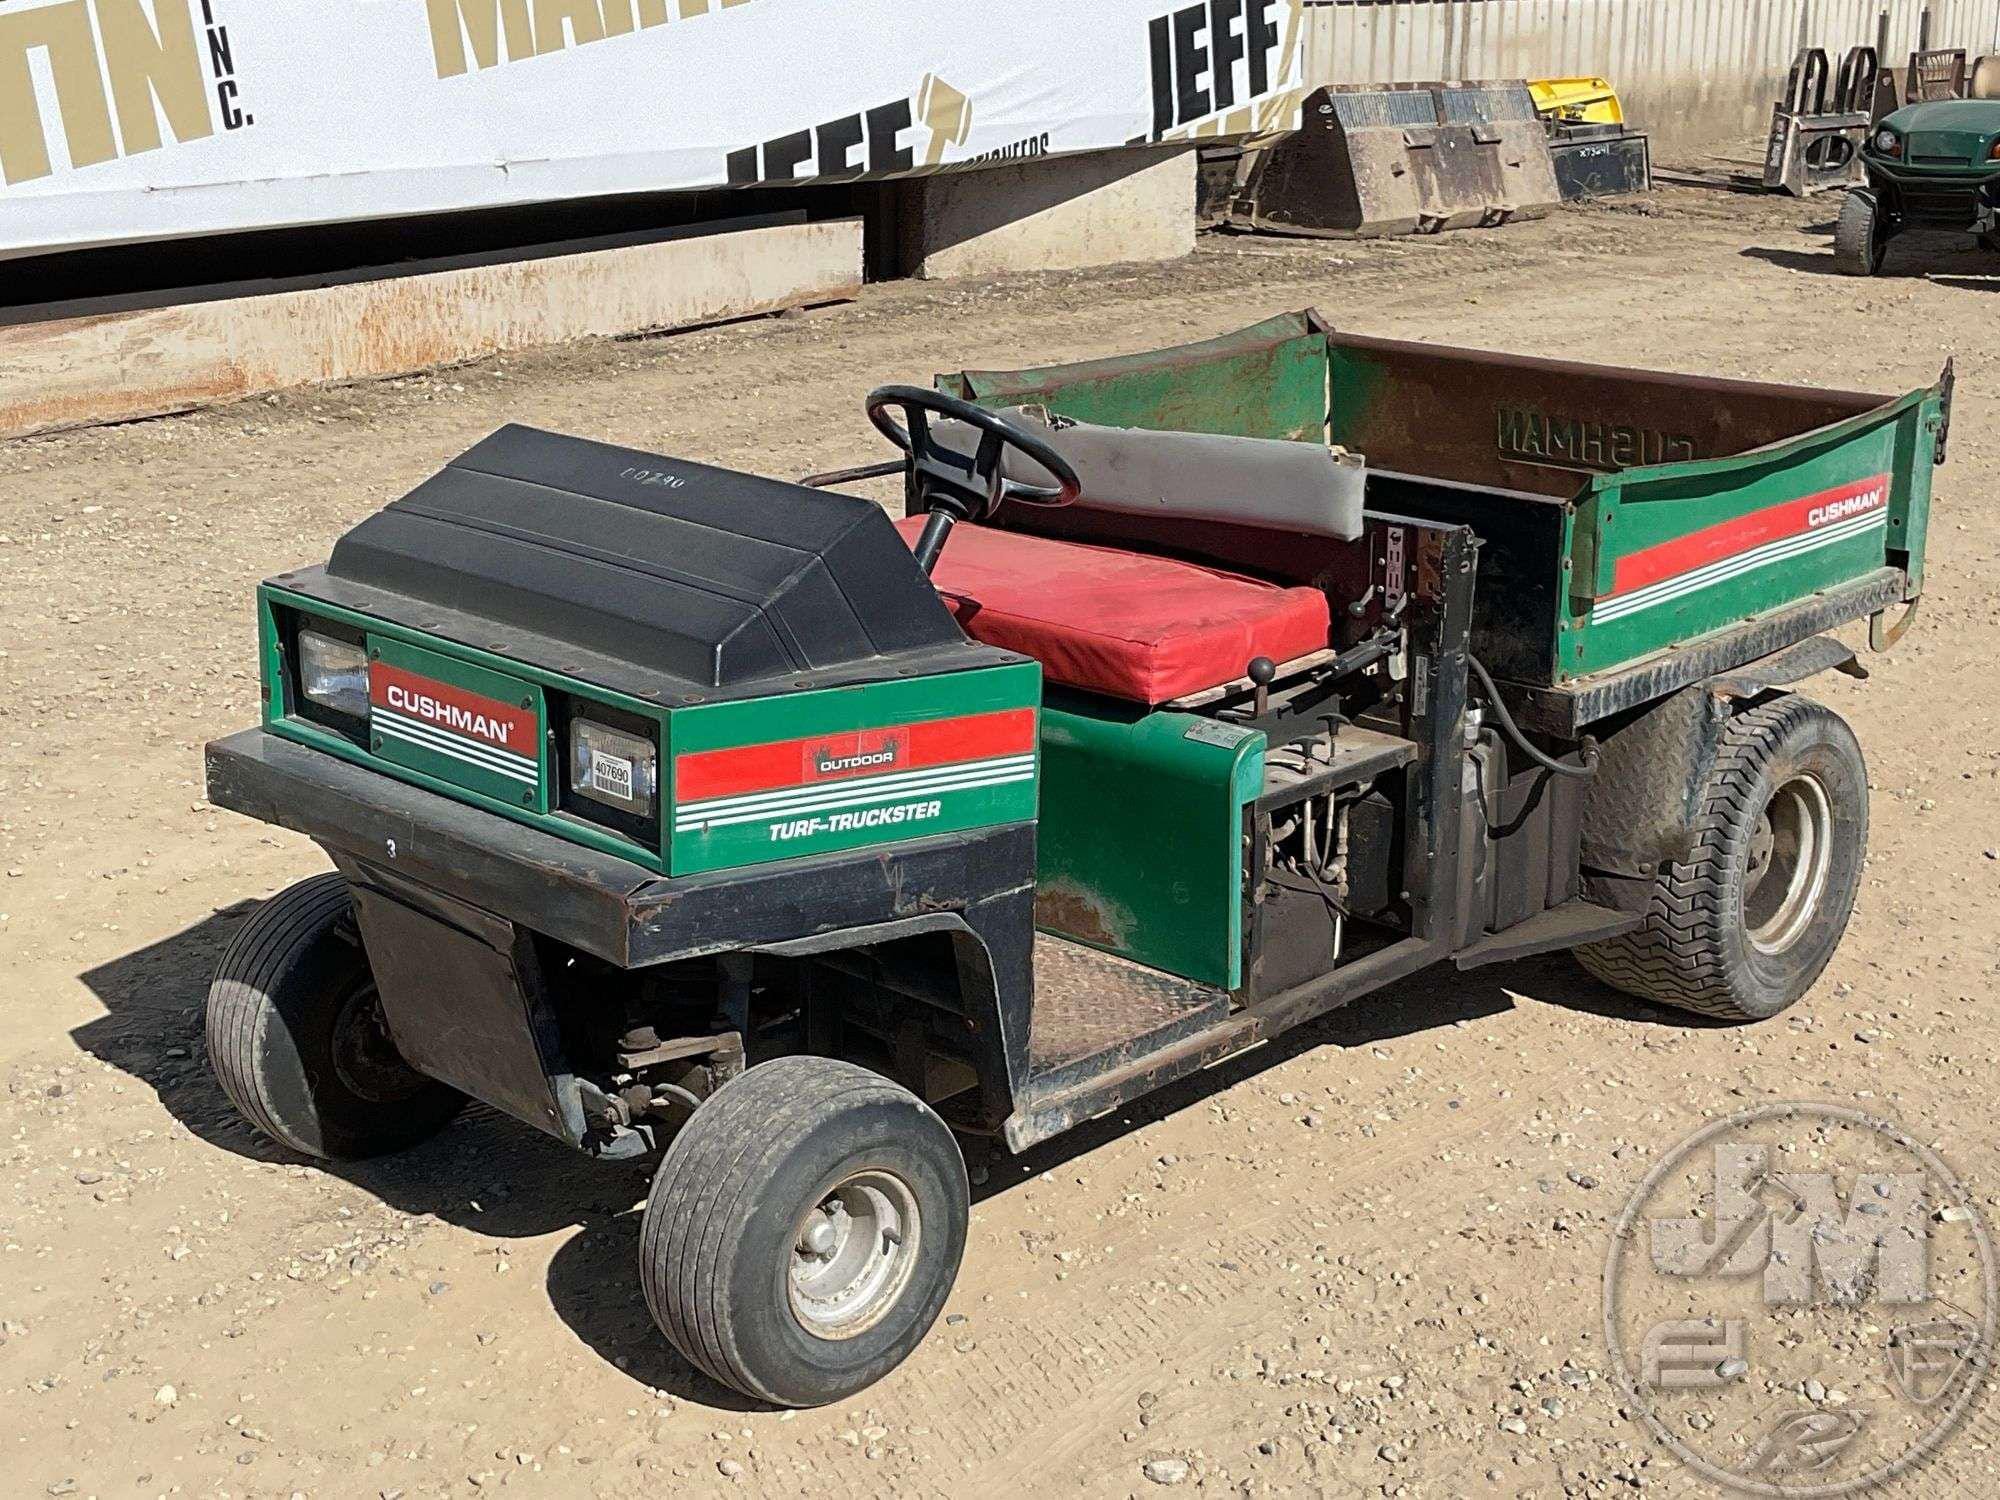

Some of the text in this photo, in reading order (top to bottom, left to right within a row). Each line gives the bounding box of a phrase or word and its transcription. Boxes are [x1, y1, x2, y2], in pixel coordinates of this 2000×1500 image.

[1126, 0, 1279, 143] JEFF
[596, 761, 629, 783] 407690
[820, 752, 894, 772] OUTDOOR
[769, 800, 941, 841] TURF-TRUCKSTER
[386, 838, 397, 859] 3
